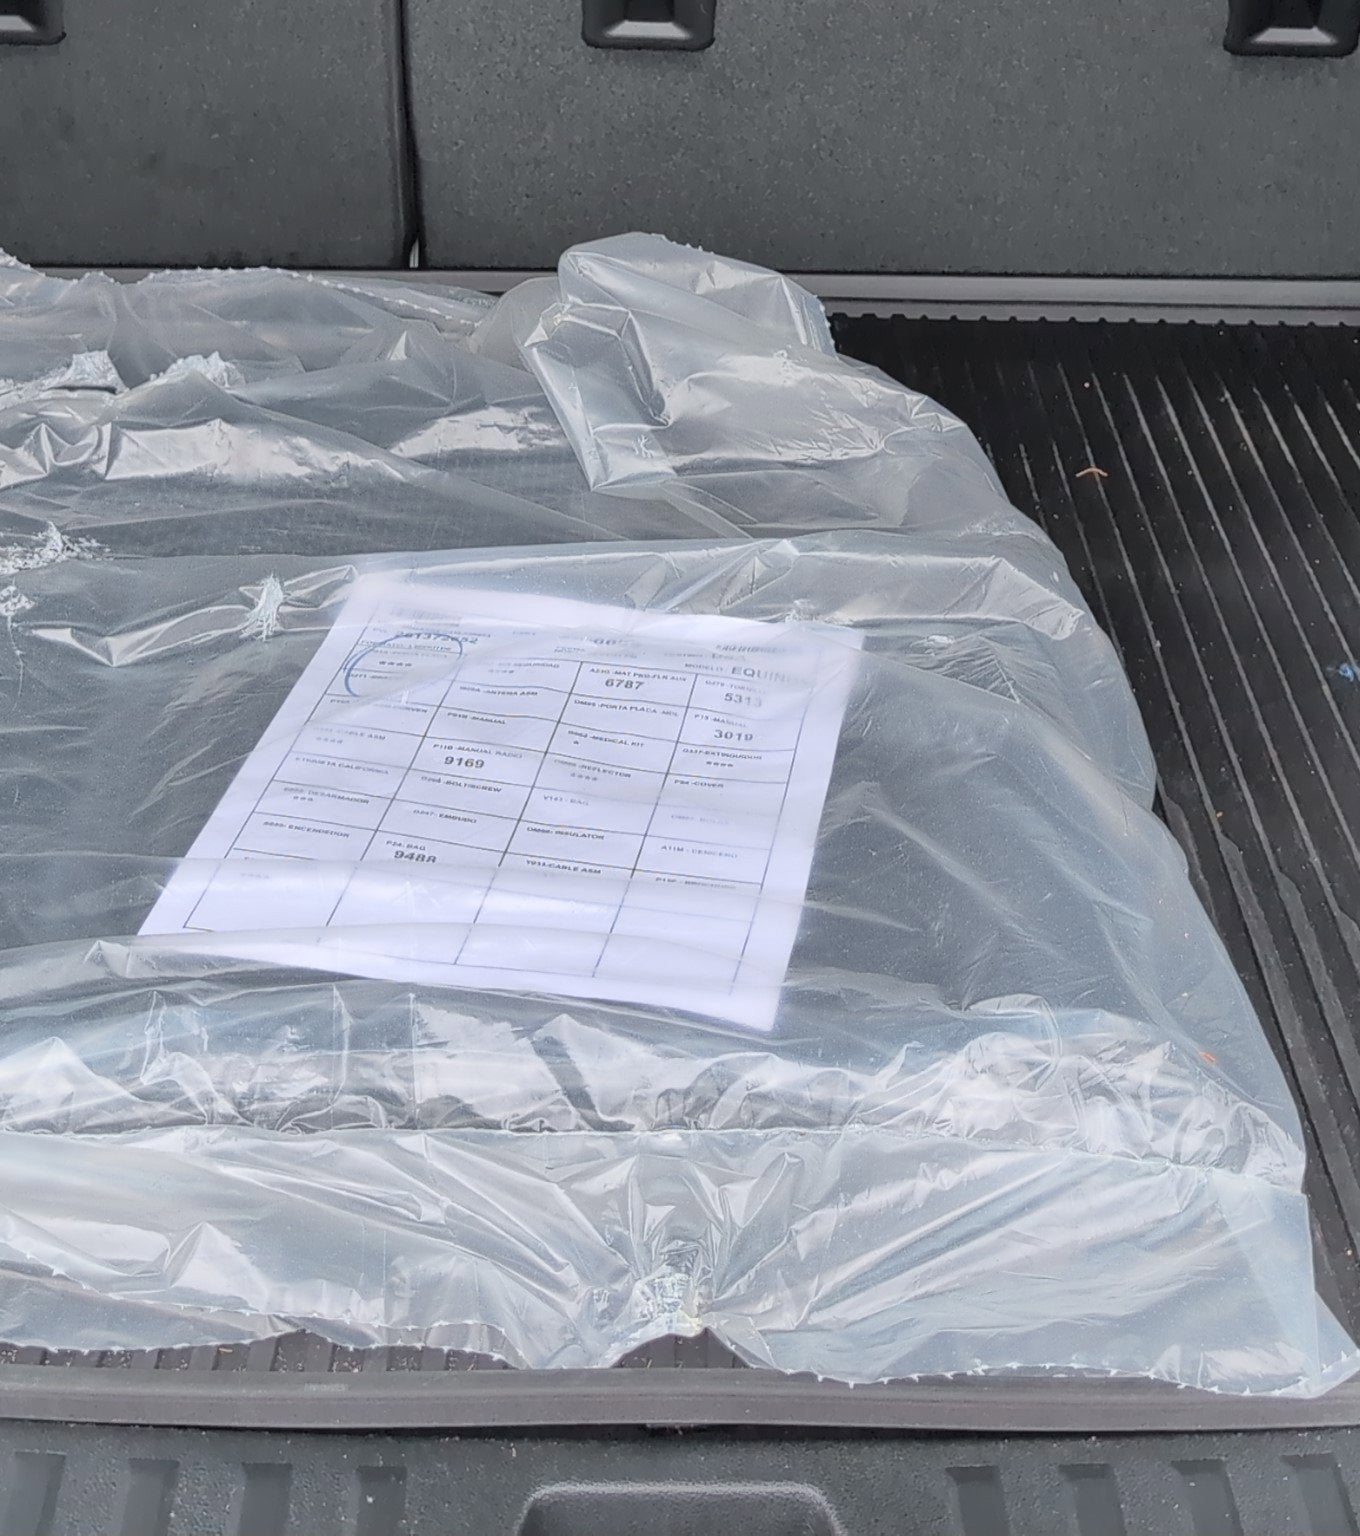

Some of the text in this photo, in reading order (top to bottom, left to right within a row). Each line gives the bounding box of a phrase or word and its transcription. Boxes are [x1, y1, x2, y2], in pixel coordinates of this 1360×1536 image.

[605, 679, 644, 690] 6787
[724, 692, 763, 707] 5313
[714, 729, 753, 741] 3019
[444, 756, 484, 768] 9169
